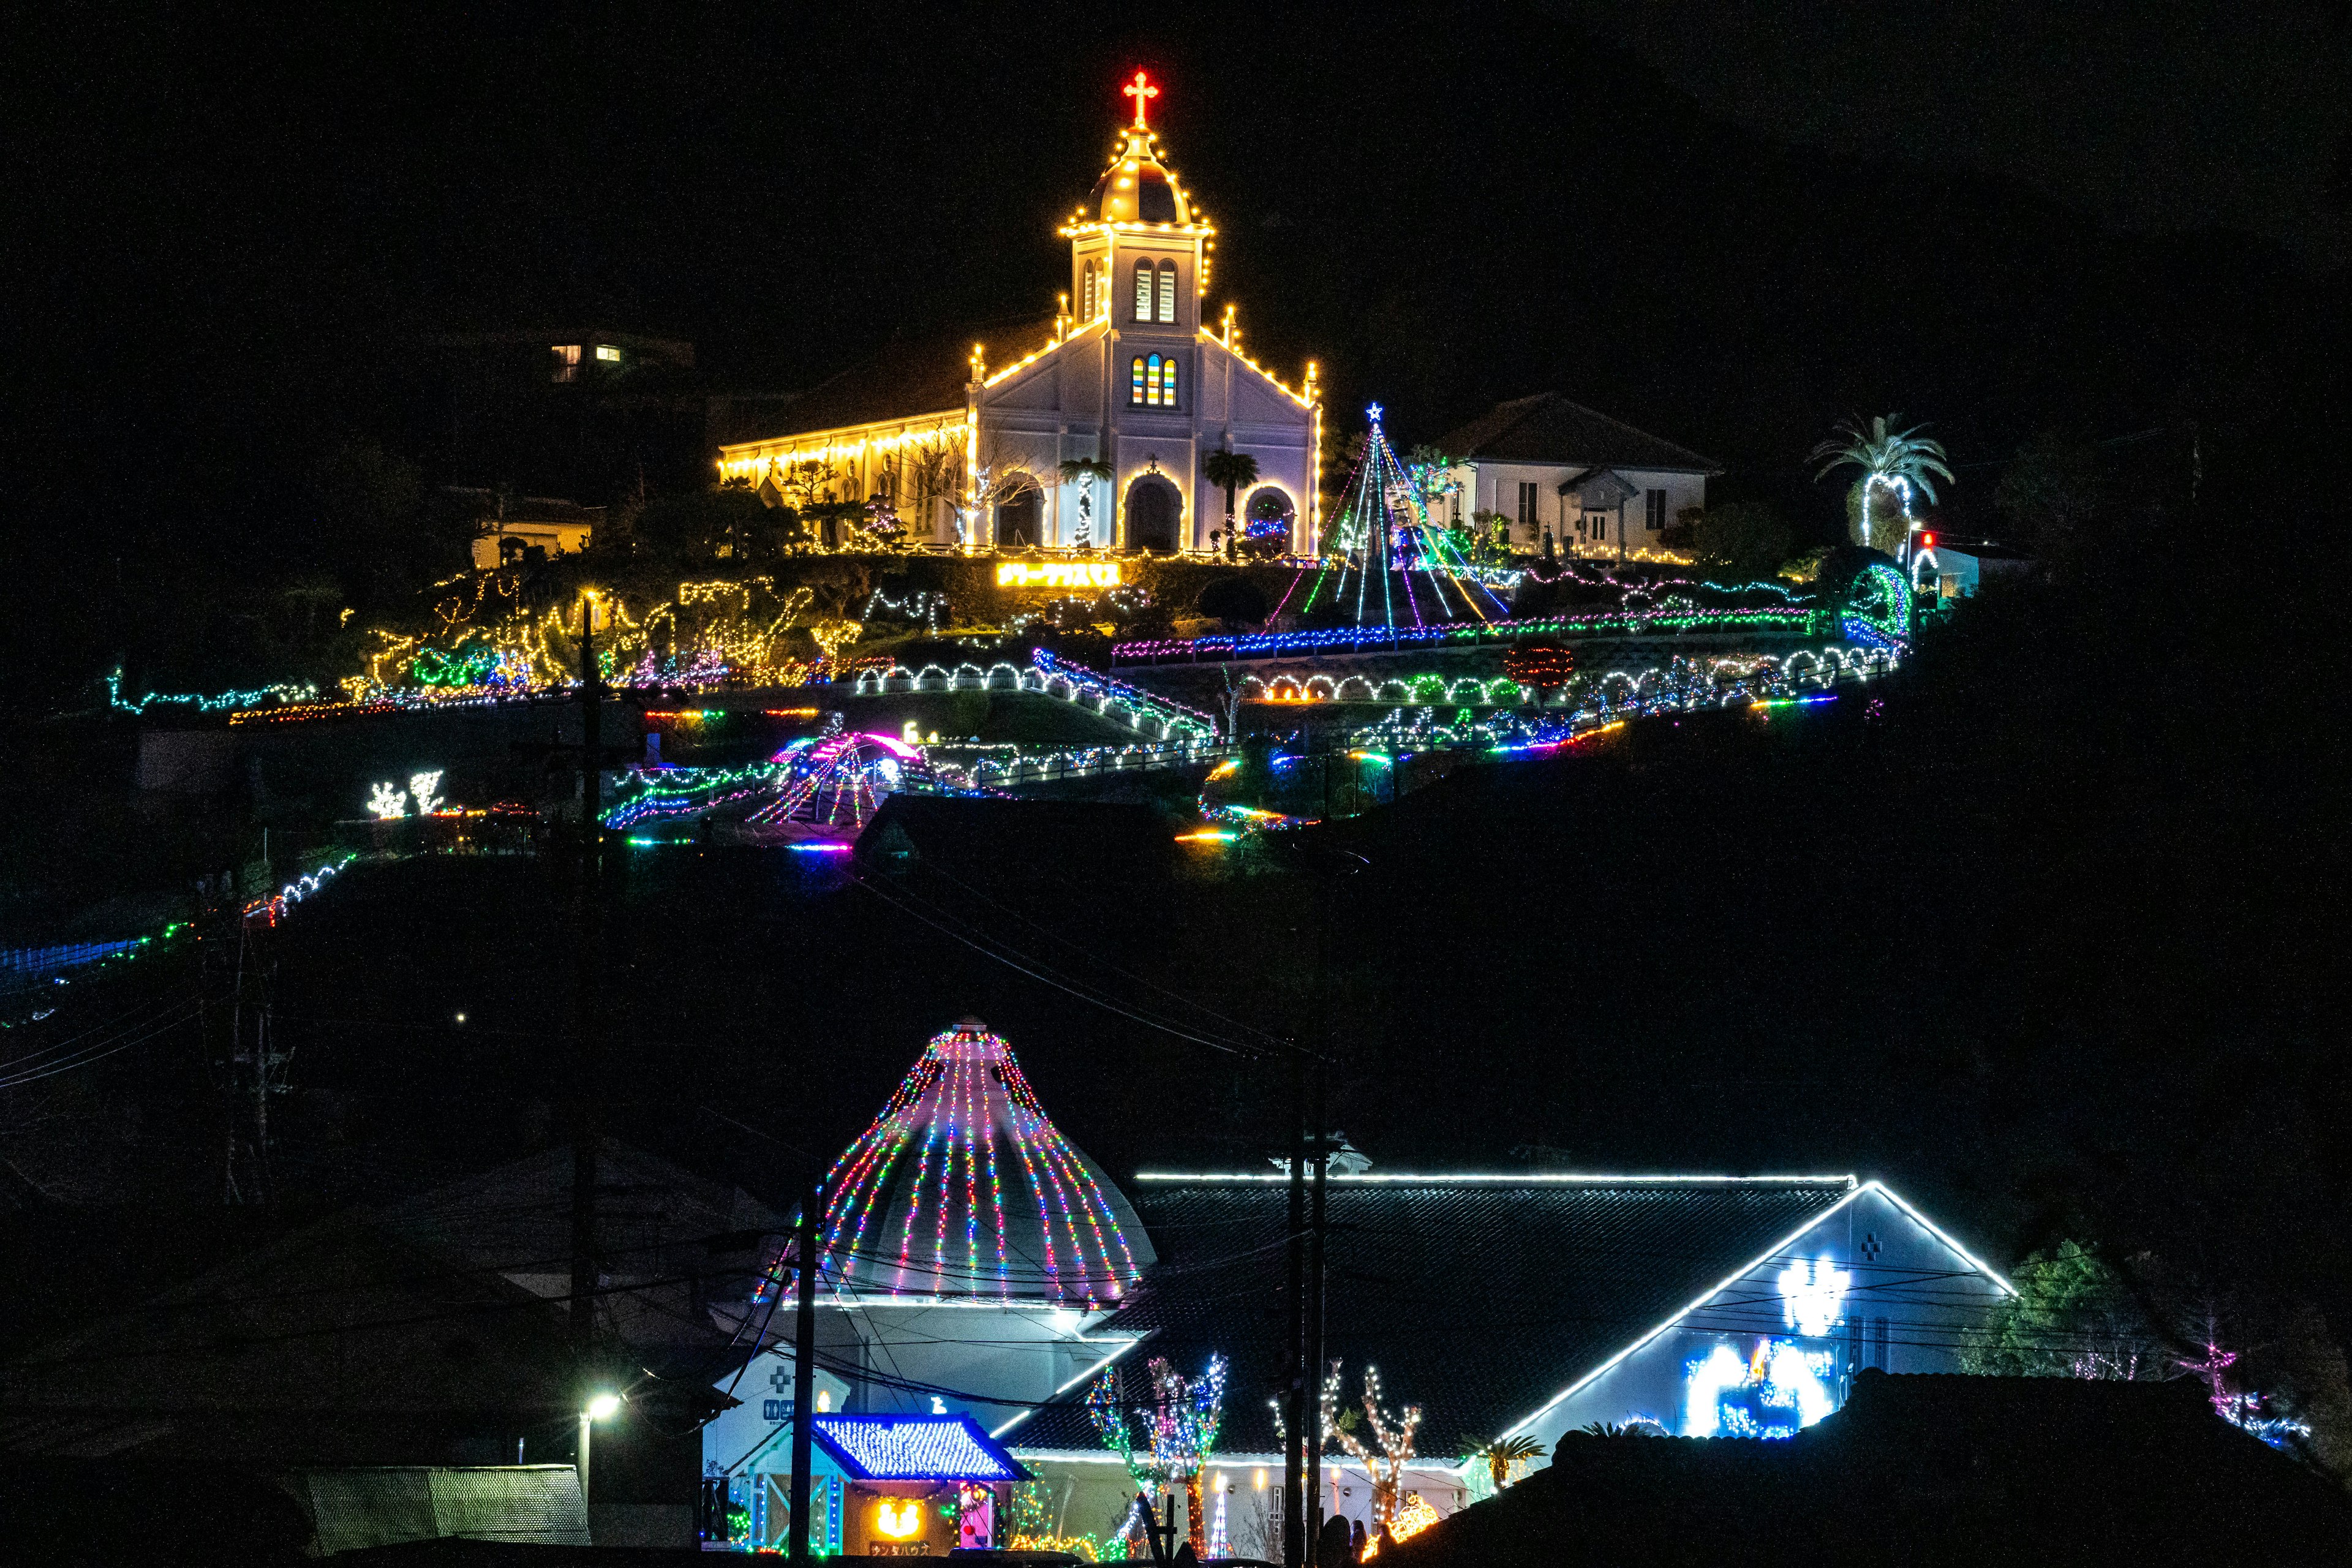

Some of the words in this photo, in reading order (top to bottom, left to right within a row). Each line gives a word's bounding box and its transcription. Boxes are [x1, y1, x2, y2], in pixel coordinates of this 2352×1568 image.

[999, 564, 1120, 586] メリークリスマス
